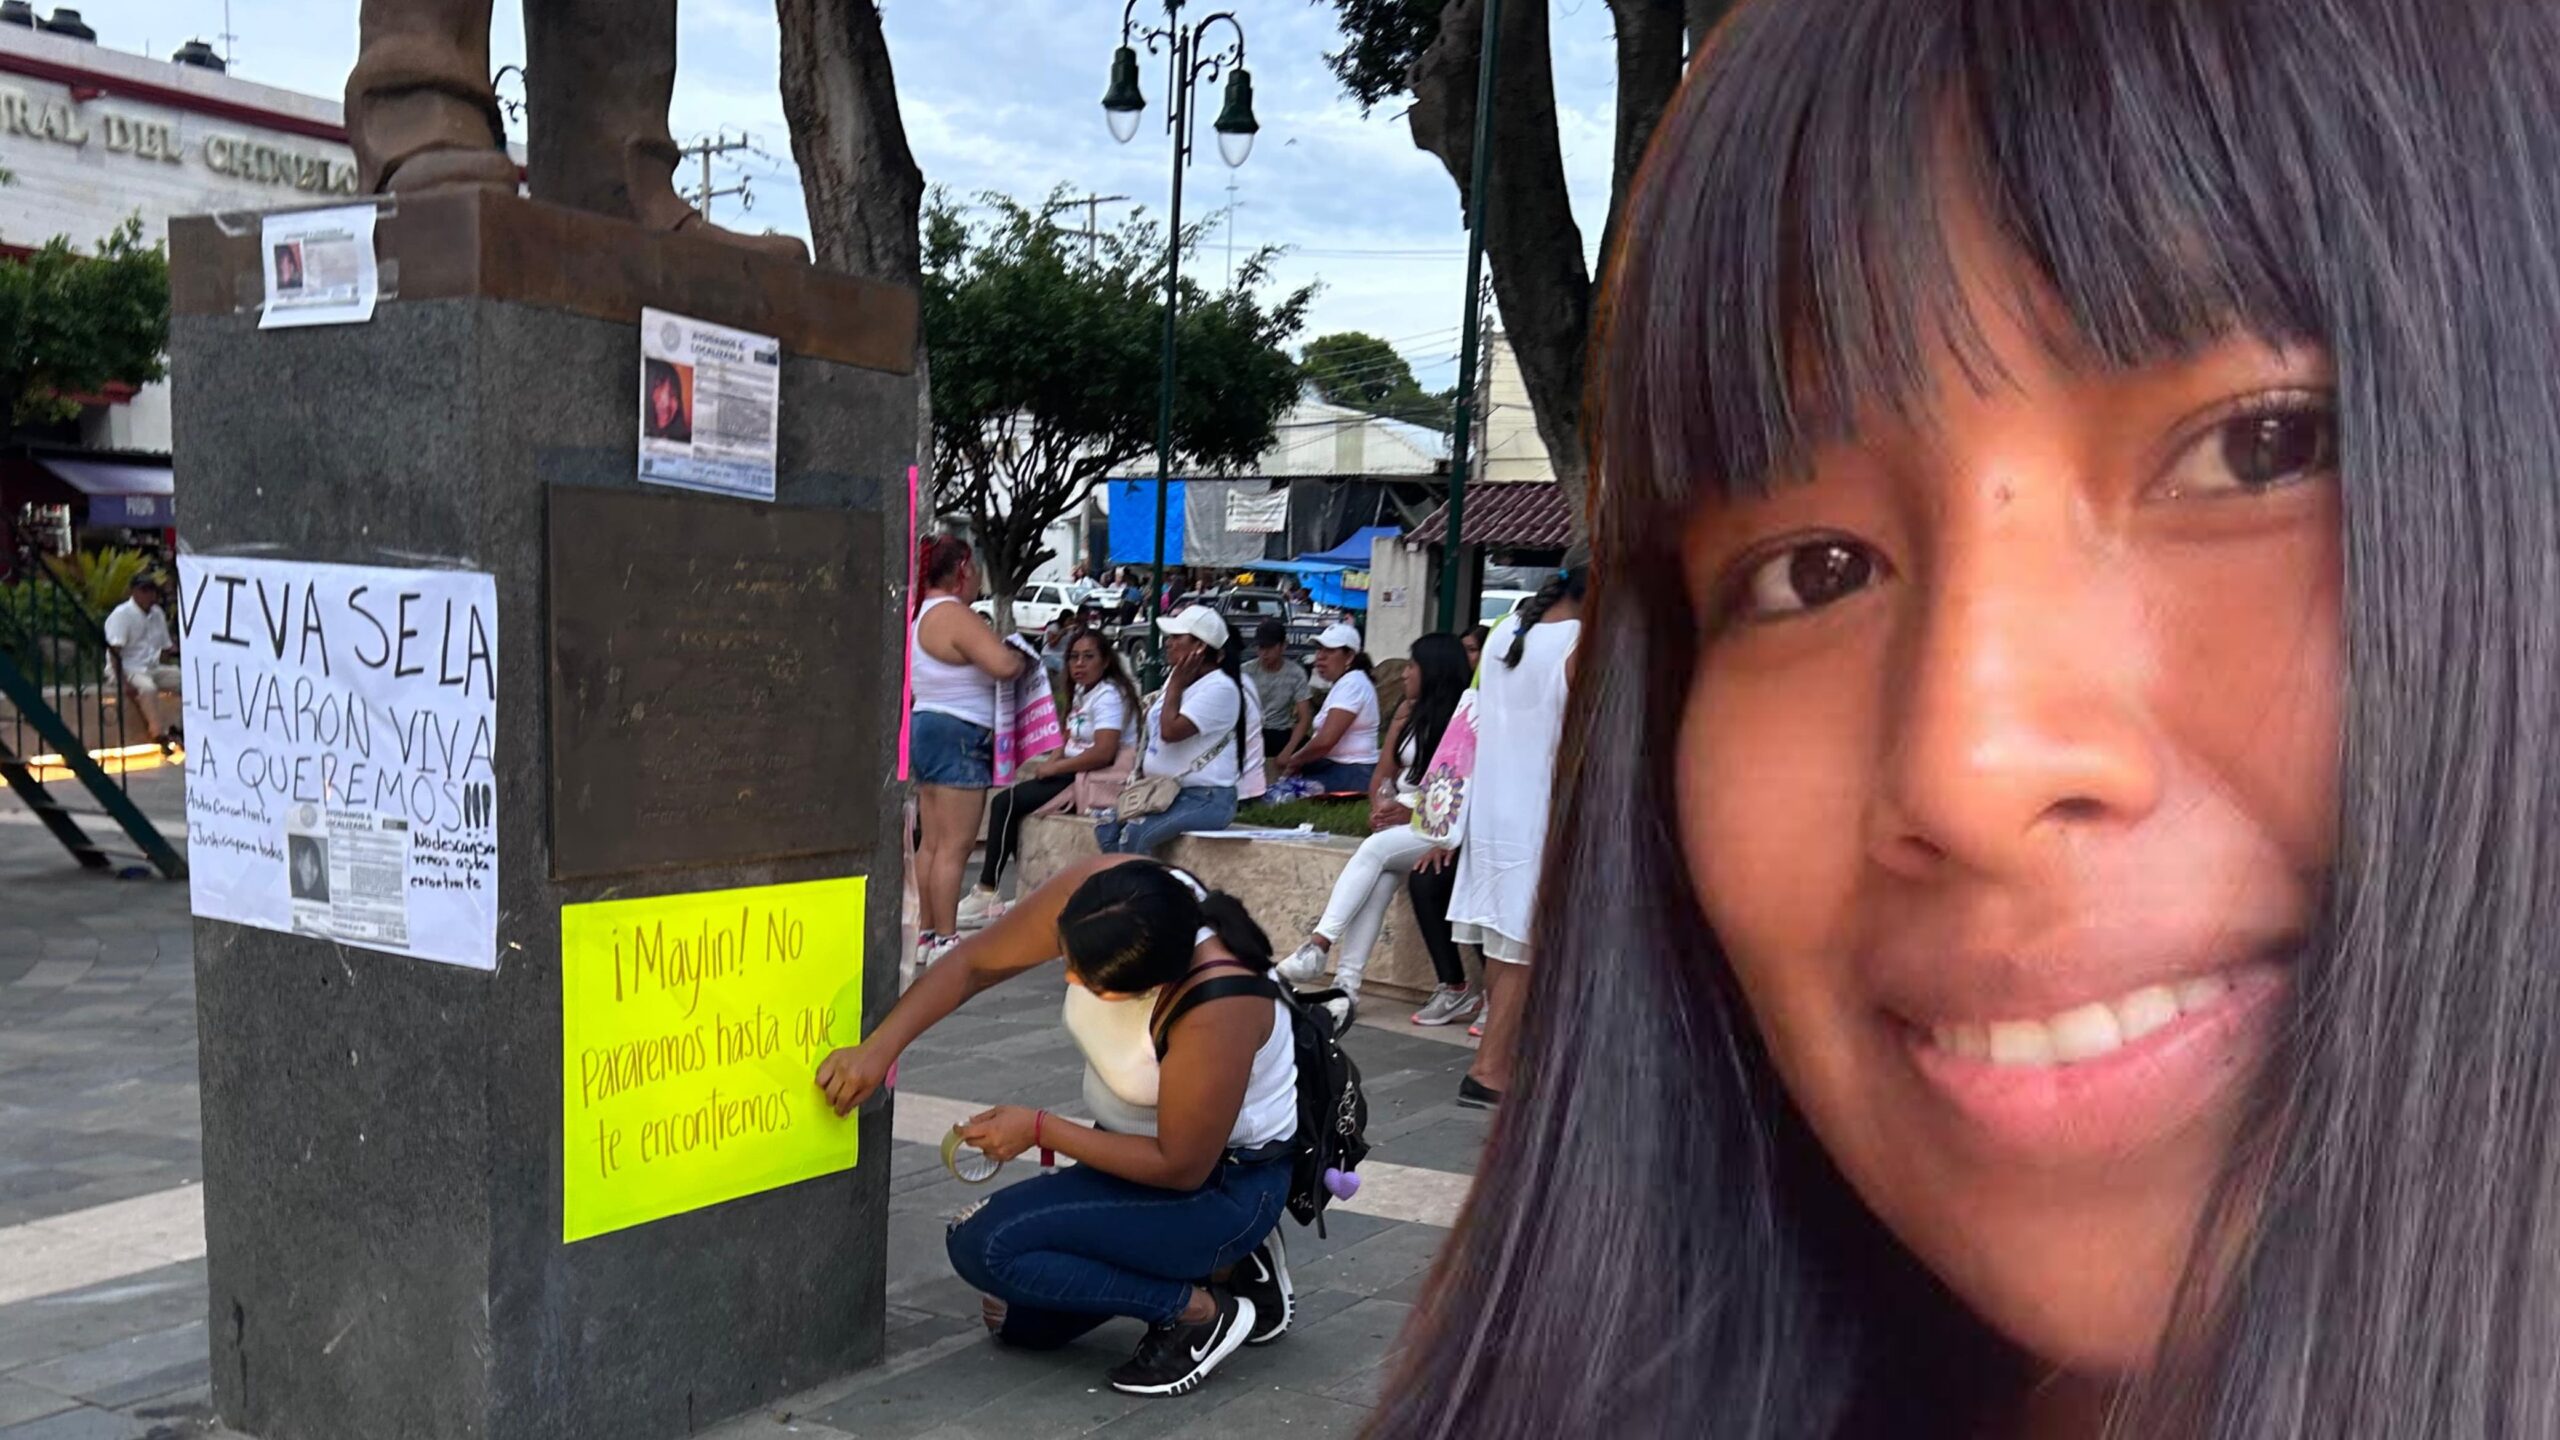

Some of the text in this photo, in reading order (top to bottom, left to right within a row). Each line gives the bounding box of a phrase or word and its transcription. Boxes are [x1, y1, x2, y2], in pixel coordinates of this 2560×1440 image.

[103, 114, 183, 165] DEL
[177, 573, 330, 677] VIVA
[348, 585, 425, 679] SE
[438, 597, 496, 701] LA
[183, 655, 497, 782] LEVARON VIVA
[186, 736, 218, 779] A
[766, 907, 804, 964] No
[716, 1003, 780, 1067] hasta
[795, 1005, 837, 1065] que
[591, 1119, 622, 1180] te
